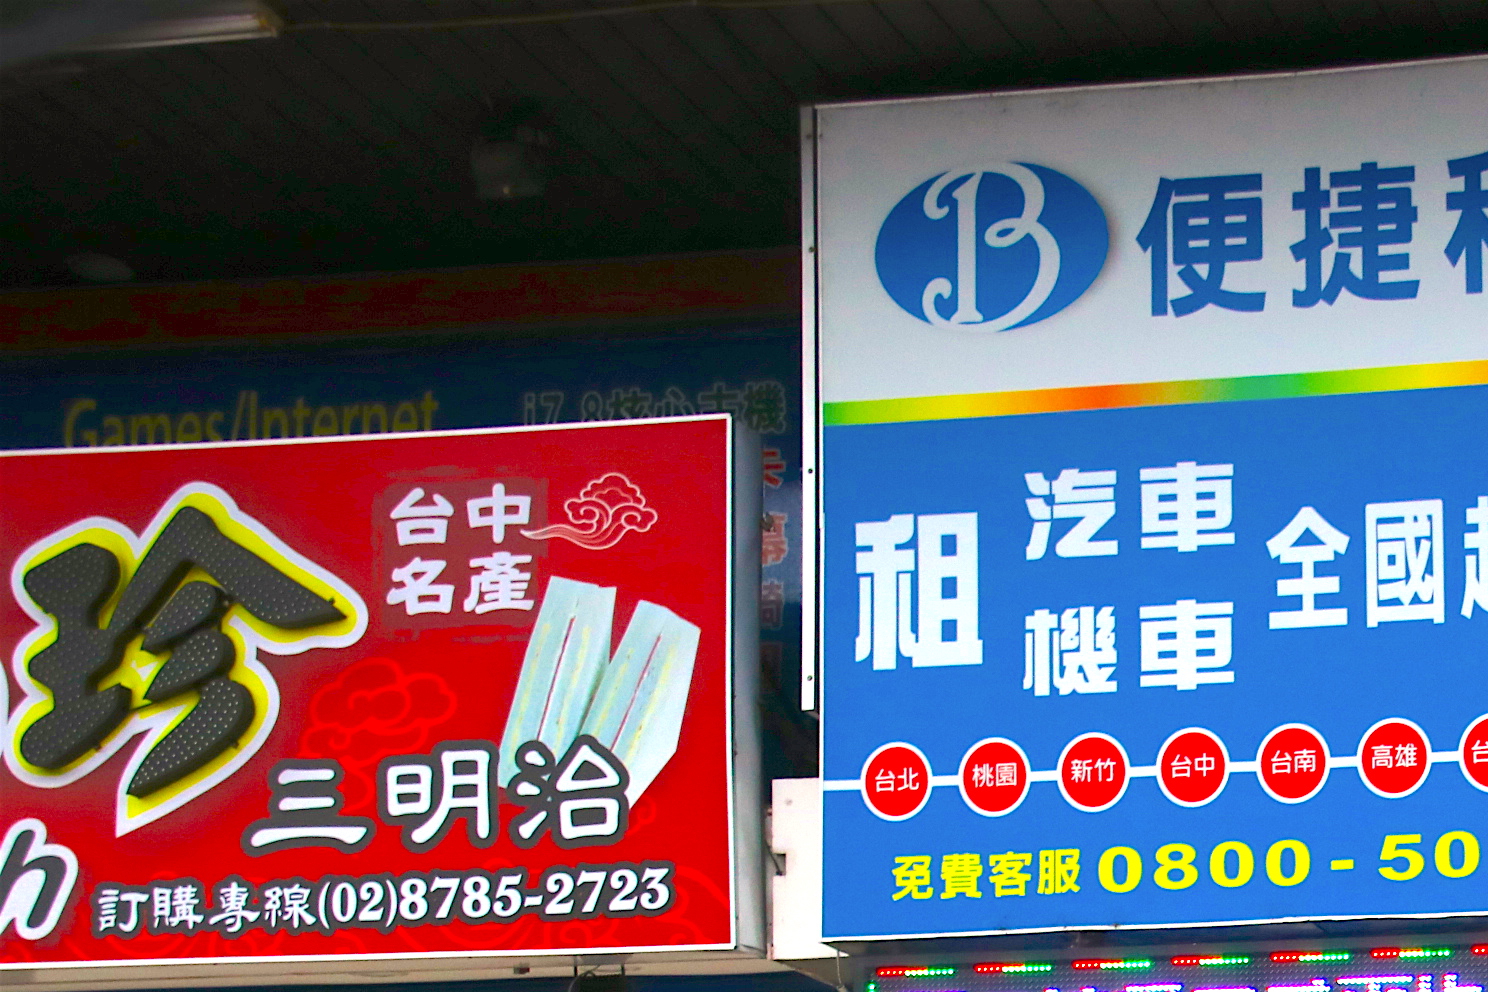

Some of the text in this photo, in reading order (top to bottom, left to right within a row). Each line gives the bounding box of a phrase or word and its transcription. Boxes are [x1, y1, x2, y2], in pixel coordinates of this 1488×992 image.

[390, 483, 532, 547] 台中
[1023, 461, 1238, 562] 汽車
[386, 552, 535, 616] 名產
[854, 510, 984, 672] 租
[8, 480, 370, 838] 珍
[1021, 599, 1237, 698] 機車
[873, 765, 920, 795] 台北
[971, 761, 1019, 790] 桃園
[1069, 755, 1117, 784] 新竹
[1169, 753, 1217, 782] 台中
[1269, 747, 1317, 777] 台南
[1370, 742, 1418, 772] 高雄
[250, 748, 628, 846] 三明治
[99, 868, 671, 934] 訂購專線(02)8785-2723
[891, 847, 1082, 902] 免費客服
